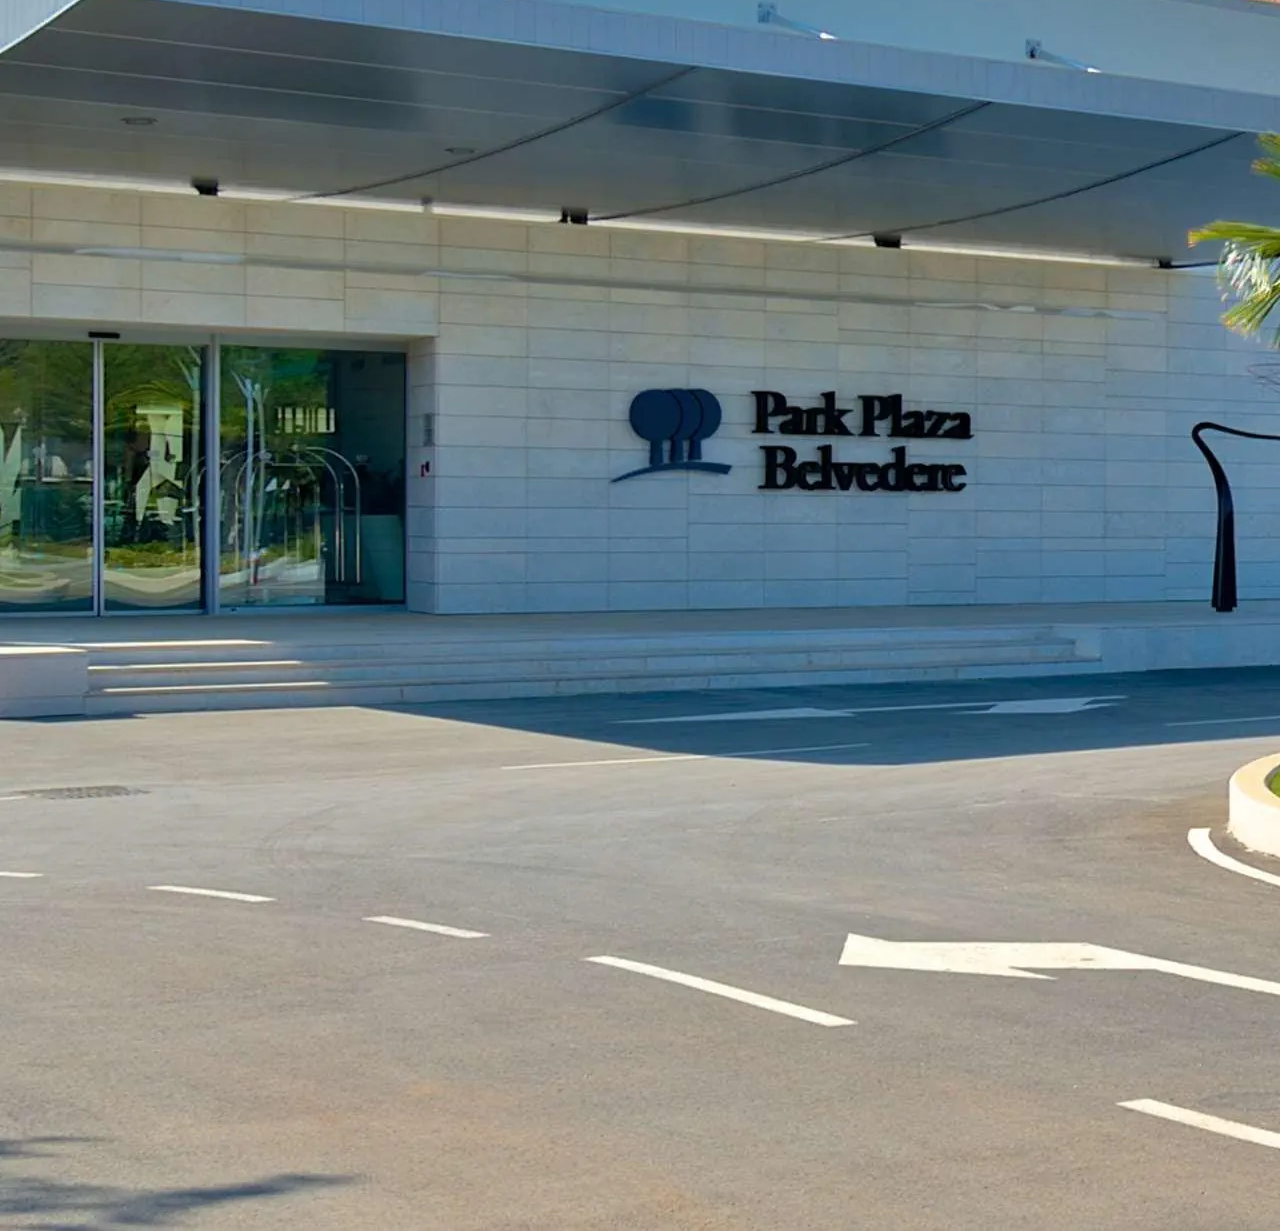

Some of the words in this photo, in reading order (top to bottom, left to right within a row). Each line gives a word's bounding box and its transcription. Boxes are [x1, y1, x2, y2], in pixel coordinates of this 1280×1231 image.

[750, 390, 855, 437] Park
[857, 393, 974, 440] Plaza
[757, 444, 967, 492] Belvedere
